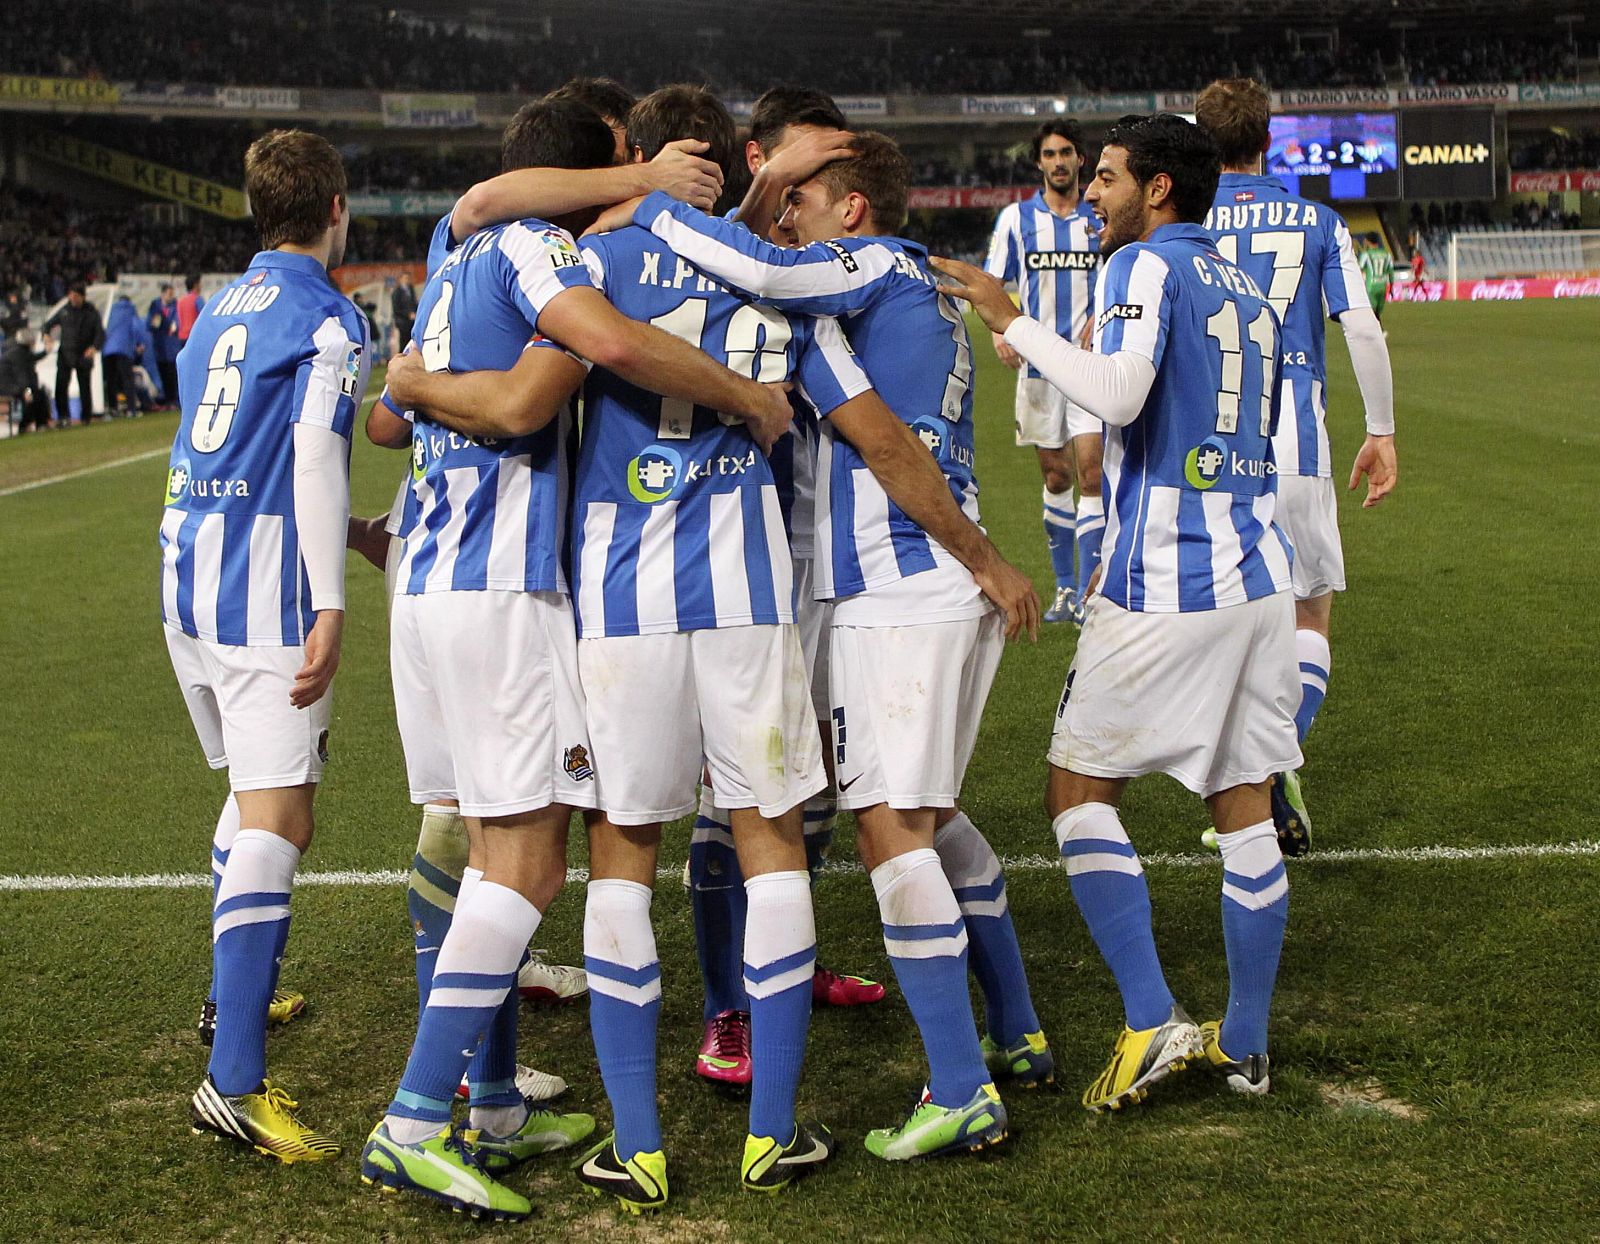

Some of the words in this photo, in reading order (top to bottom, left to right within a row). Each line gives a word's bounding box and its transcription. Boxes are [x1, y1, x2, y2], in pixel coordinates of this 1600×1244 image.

[1298, 92, 1343, 104] DIARIO
[1345, 91, 1390, 103] VASCO
[1415, 88, 1461, 101] DIARIO
[1464, 86, 1509, 99] VASCO
[1308, 143, 1323, 163] 2
[1341, 142, 1354, 163] 2
[1404, 144, 1489, 165] CANAL+
[134, 162, 223, 208] KELER
[550, 252, 580, 268] LFP
[1028, 252, 1096, 269] CANAL+
[1215, 231, 1305, 326] 17
[1205, 299, 1276, 438] 11
[190, 323, 248, 454] 6
